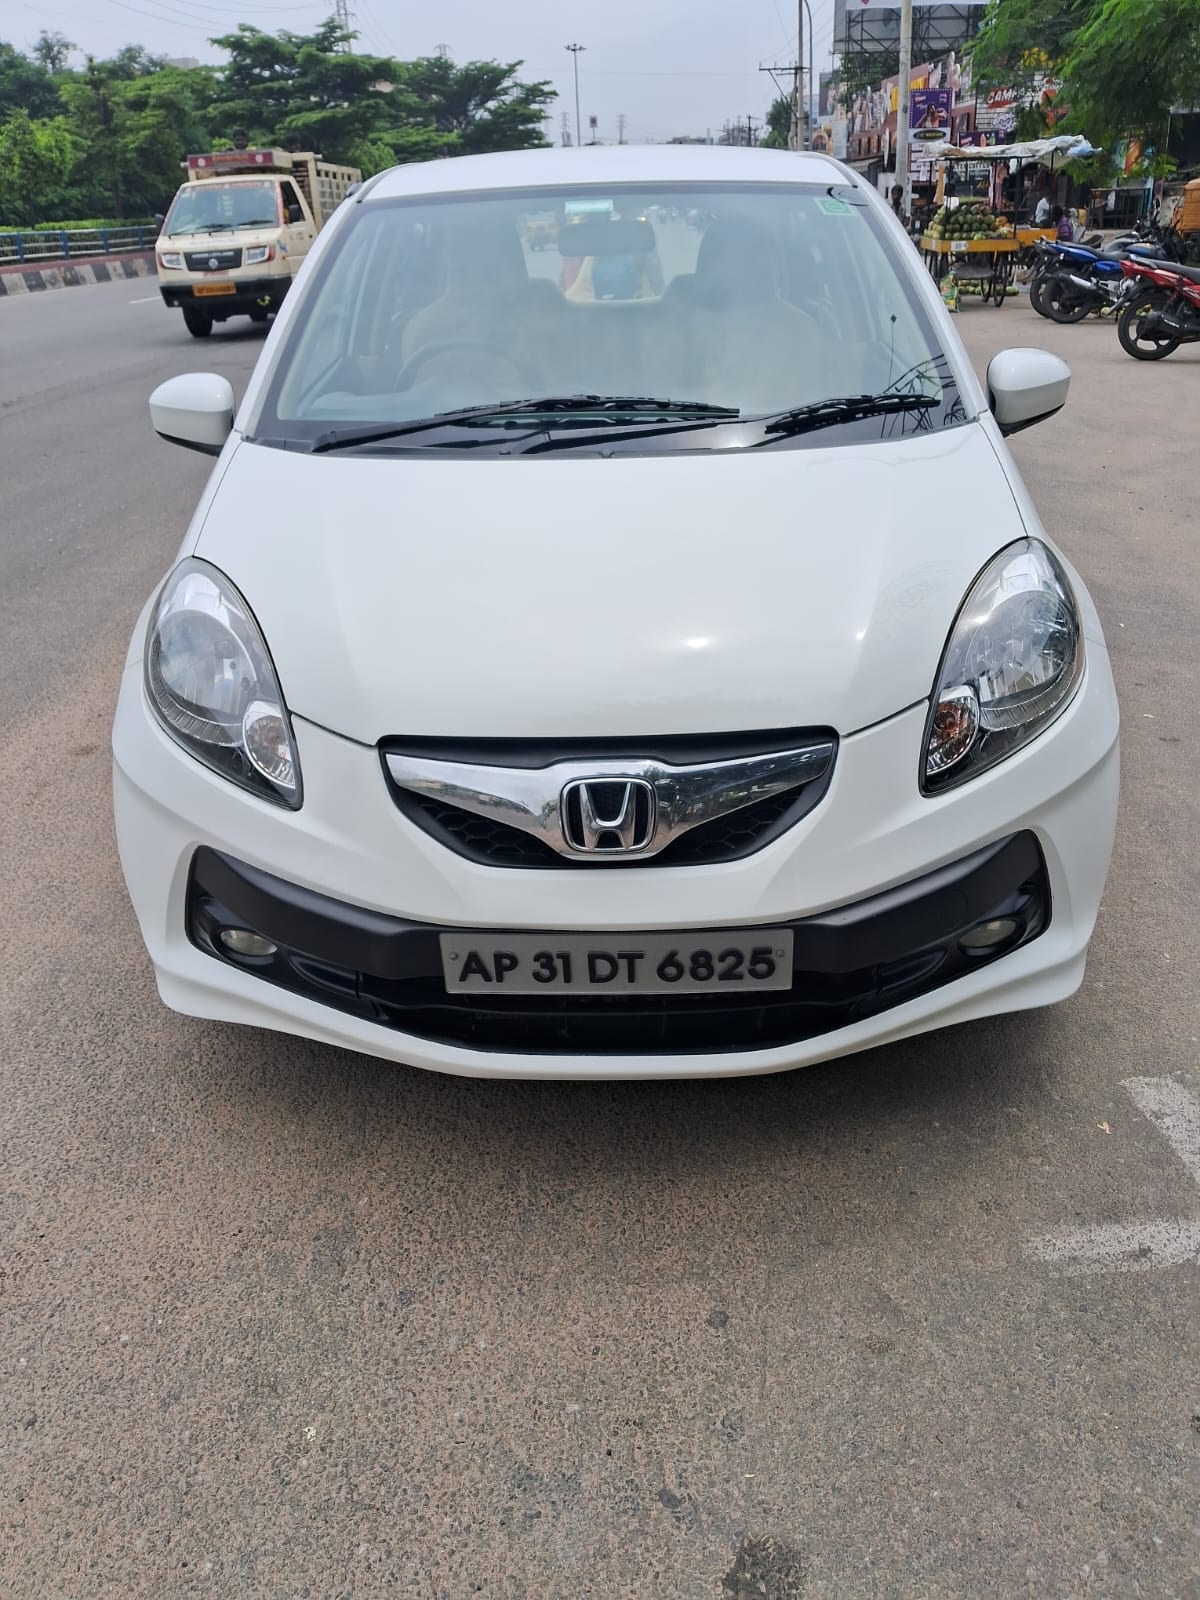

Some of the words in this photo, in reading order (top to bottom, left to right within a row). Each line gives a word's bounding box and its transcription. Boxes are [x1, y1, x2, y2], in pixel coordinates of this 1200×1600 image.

[458, 951, 519, 983] AP
[532, 951, 572, 984] 31
[588, 952, 645, 984] DT
[656, 946, 777, 982] 6825
